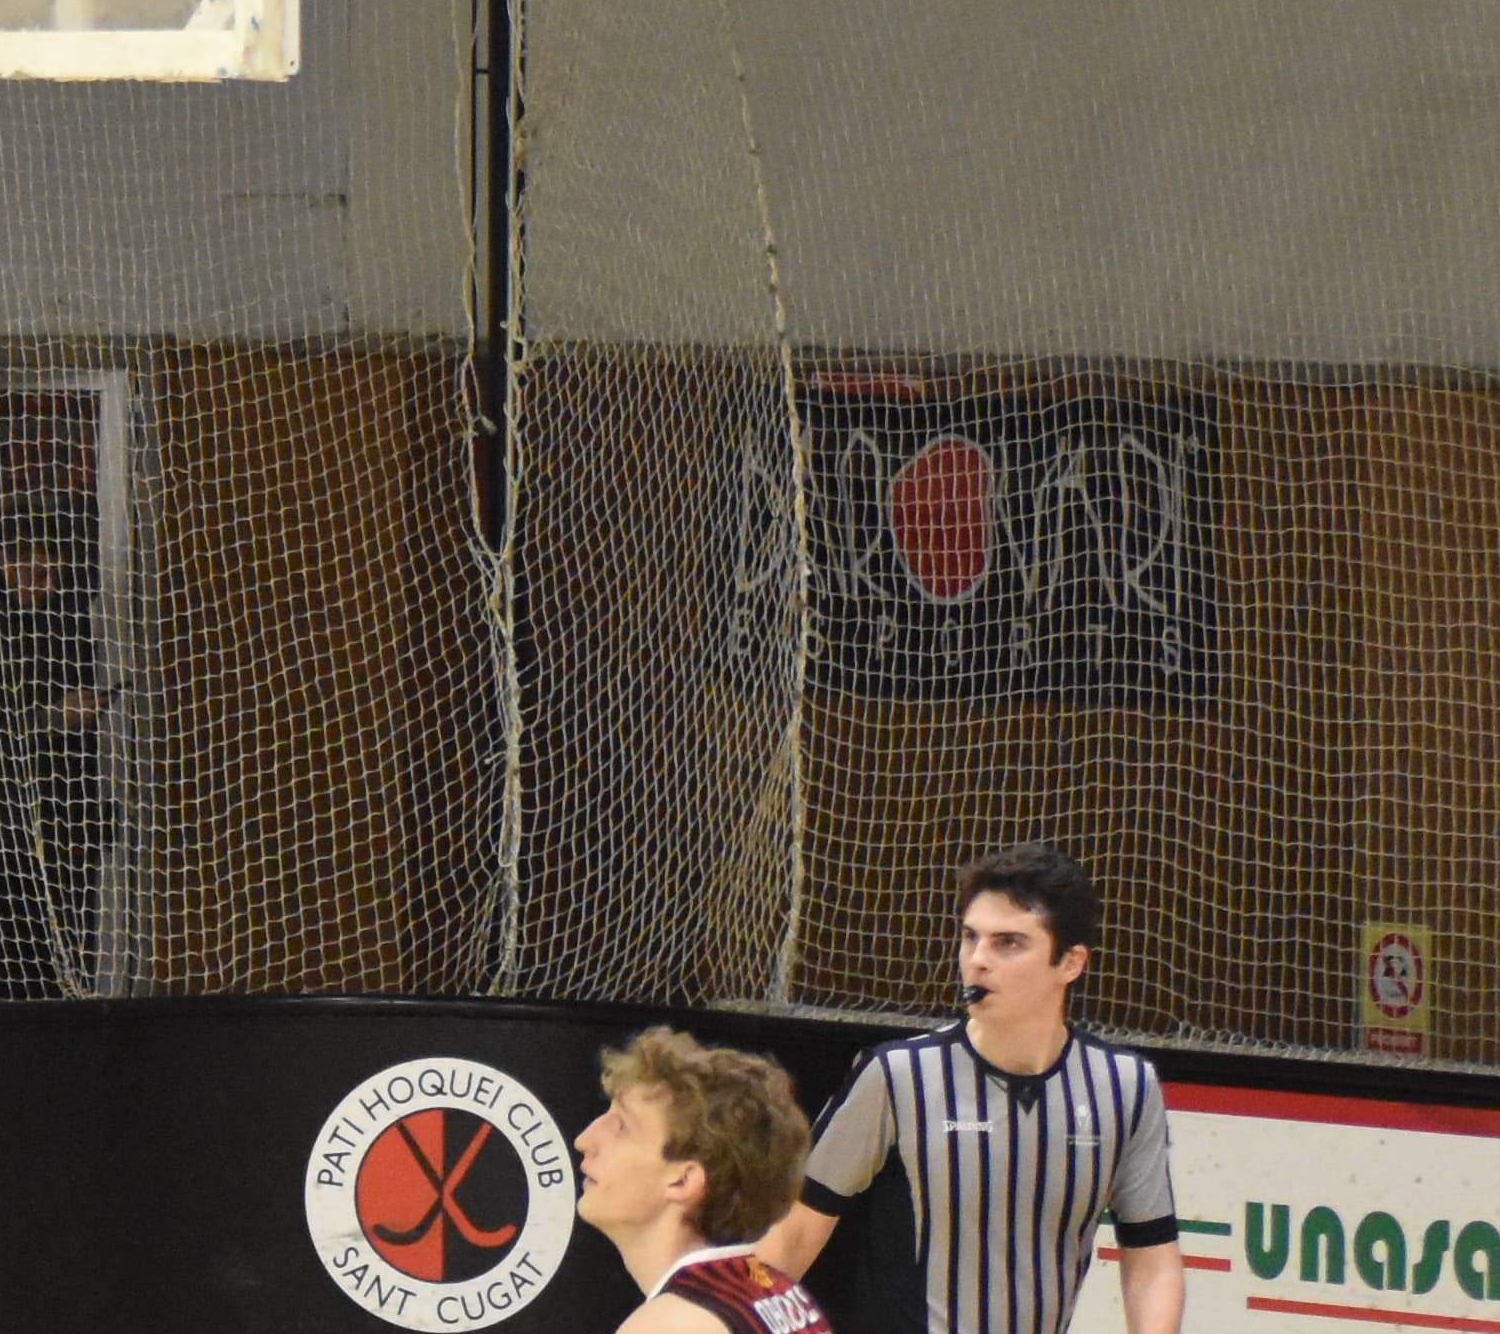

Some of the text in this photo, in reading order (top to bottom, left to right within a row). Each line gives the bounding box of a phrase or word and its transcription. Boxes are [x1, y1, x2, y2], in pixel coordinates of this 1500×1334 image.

[316, 1068, 564, 1190] PATI HOQUEI CLUB
[332, 1245, 546, 1325] SANT CUGAT
